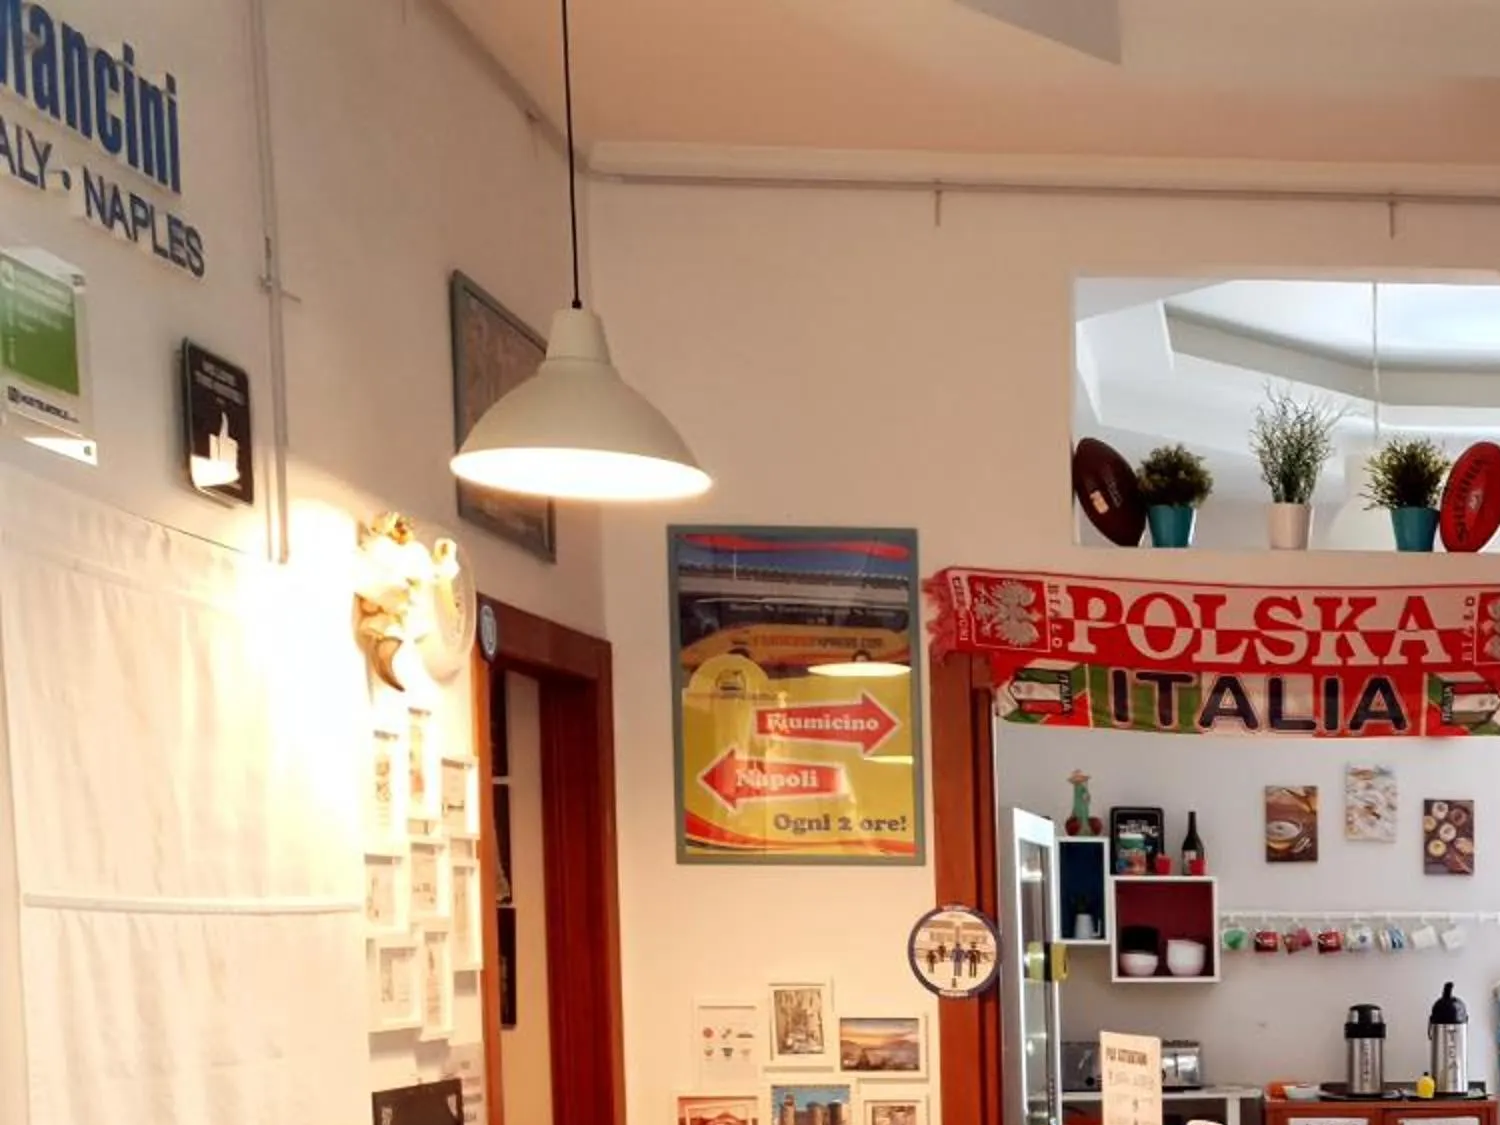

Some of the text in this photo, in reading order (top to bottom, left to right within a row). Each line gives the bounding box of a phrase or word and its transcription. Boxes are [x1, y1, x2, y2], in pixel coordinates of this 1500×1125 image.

[83, 165, 204, 277] NAPLES
[1067, 586, 1451, 666] POLSKA
[766, 711, 879, 731] Fiumicino
[1111, 668, 1410, 734] ITALIA
[736, 768, 819, 790] Napoli
[773, 814, 831, 834] Ogni
[837, 816, 853, 832] 2
